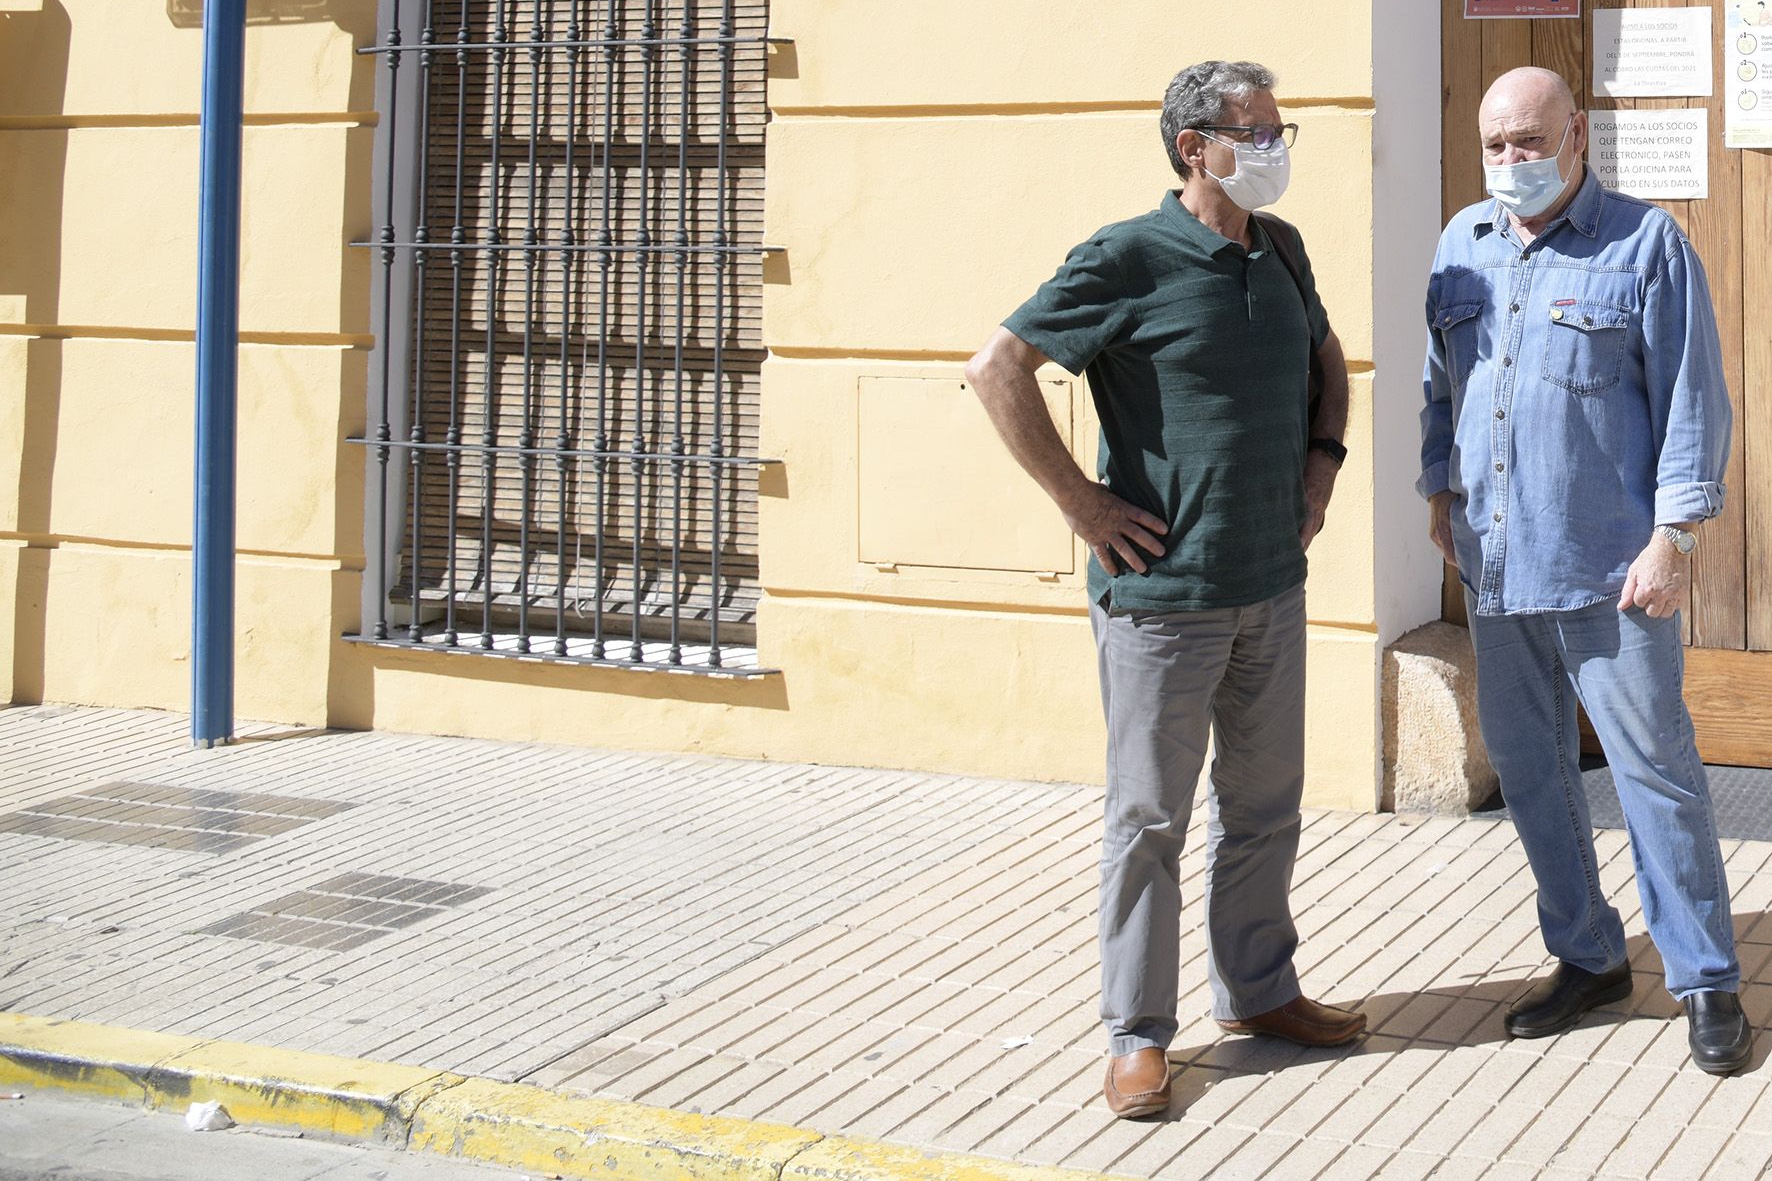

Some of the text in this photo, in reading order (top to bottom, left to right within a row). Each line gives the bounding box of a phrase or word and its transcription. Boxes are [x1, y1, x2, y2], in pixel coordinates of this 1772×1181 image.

[1656, 22, 1678, 30] SOCIOS
[1593, 121, 1698, 131] ROGAMOS A LOS SOCIOS
[1598, 136, 1693, 146] QUE TENGAN CORREO
[1663, 151, 1691, 159] PASEN
[1600, 165, 1692, 174] POR LA OFICINA PARA
[1600, 179, 1700, 189] CLUIRLO EN SUS DATOS
